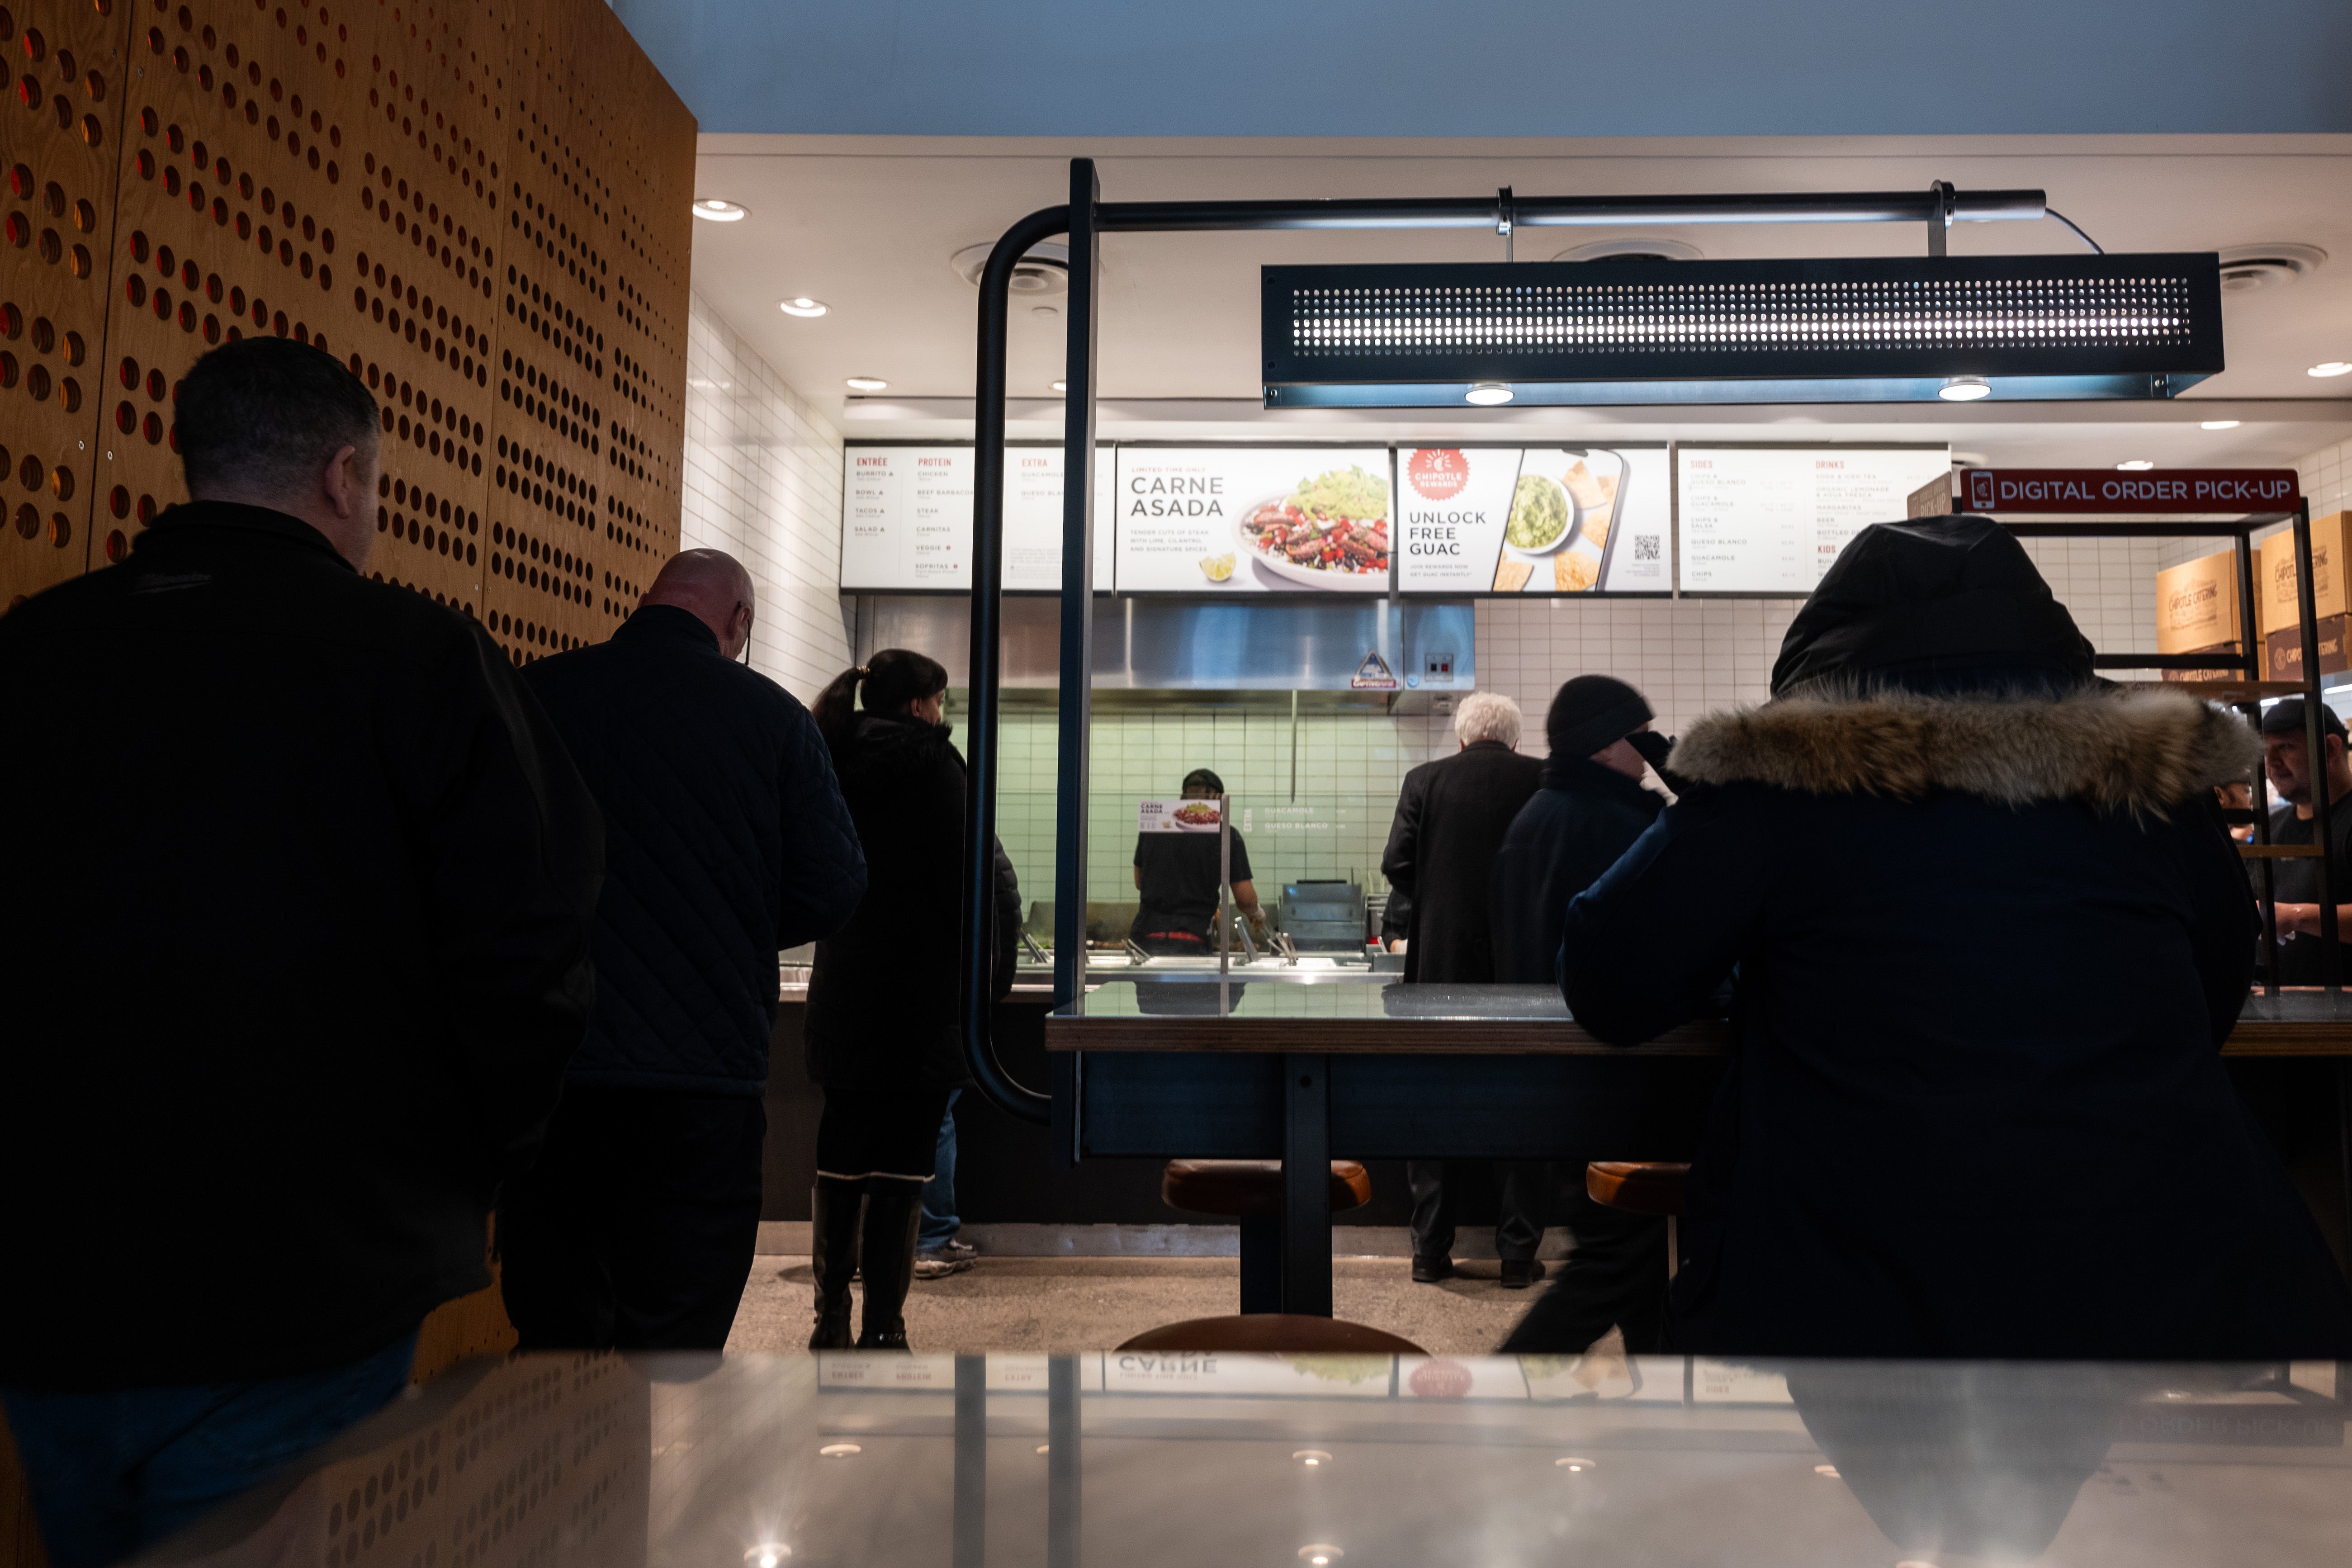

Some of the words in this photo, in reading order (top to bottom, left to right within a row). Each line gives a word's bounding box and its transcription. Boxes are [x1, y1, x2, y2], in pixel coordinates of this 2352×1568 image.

[857, 455, 888, 466] ENTRÉE
[918, 458, 951, 467] PROTEIN
[1022, 459, 1048, 467] EXTRA
[1690, 460, 1713, 469] SIDES
[1816, 460, 1845, 469] DRINKS
[1415, 472, 1462, 480] CHIPOTLE
[1131, 476, 1224, 494] CARNE
[2001, 480, 2095, 501] DIGITAL
[2101, 480, 2188, 500] ORDER
[2196, 479, 2291, 500] PICK-UP
[1130, 498, 1224, 517] ASADA
[1410, 512, 1486, 524] UNLOCK
[1410, 527, 1456, 540] FREE
[1409, 542, 1461, 556] GUAC
[1817, 545, 1836, 554] KIDS
[2275, 564, 2297, 583] CHIPOTL
[2168, 593, 2192, 612] CHIPOTLE
[2193, 583, 2218, 604] CATERING
[2286, 647, 2302, 663] CHIPO
